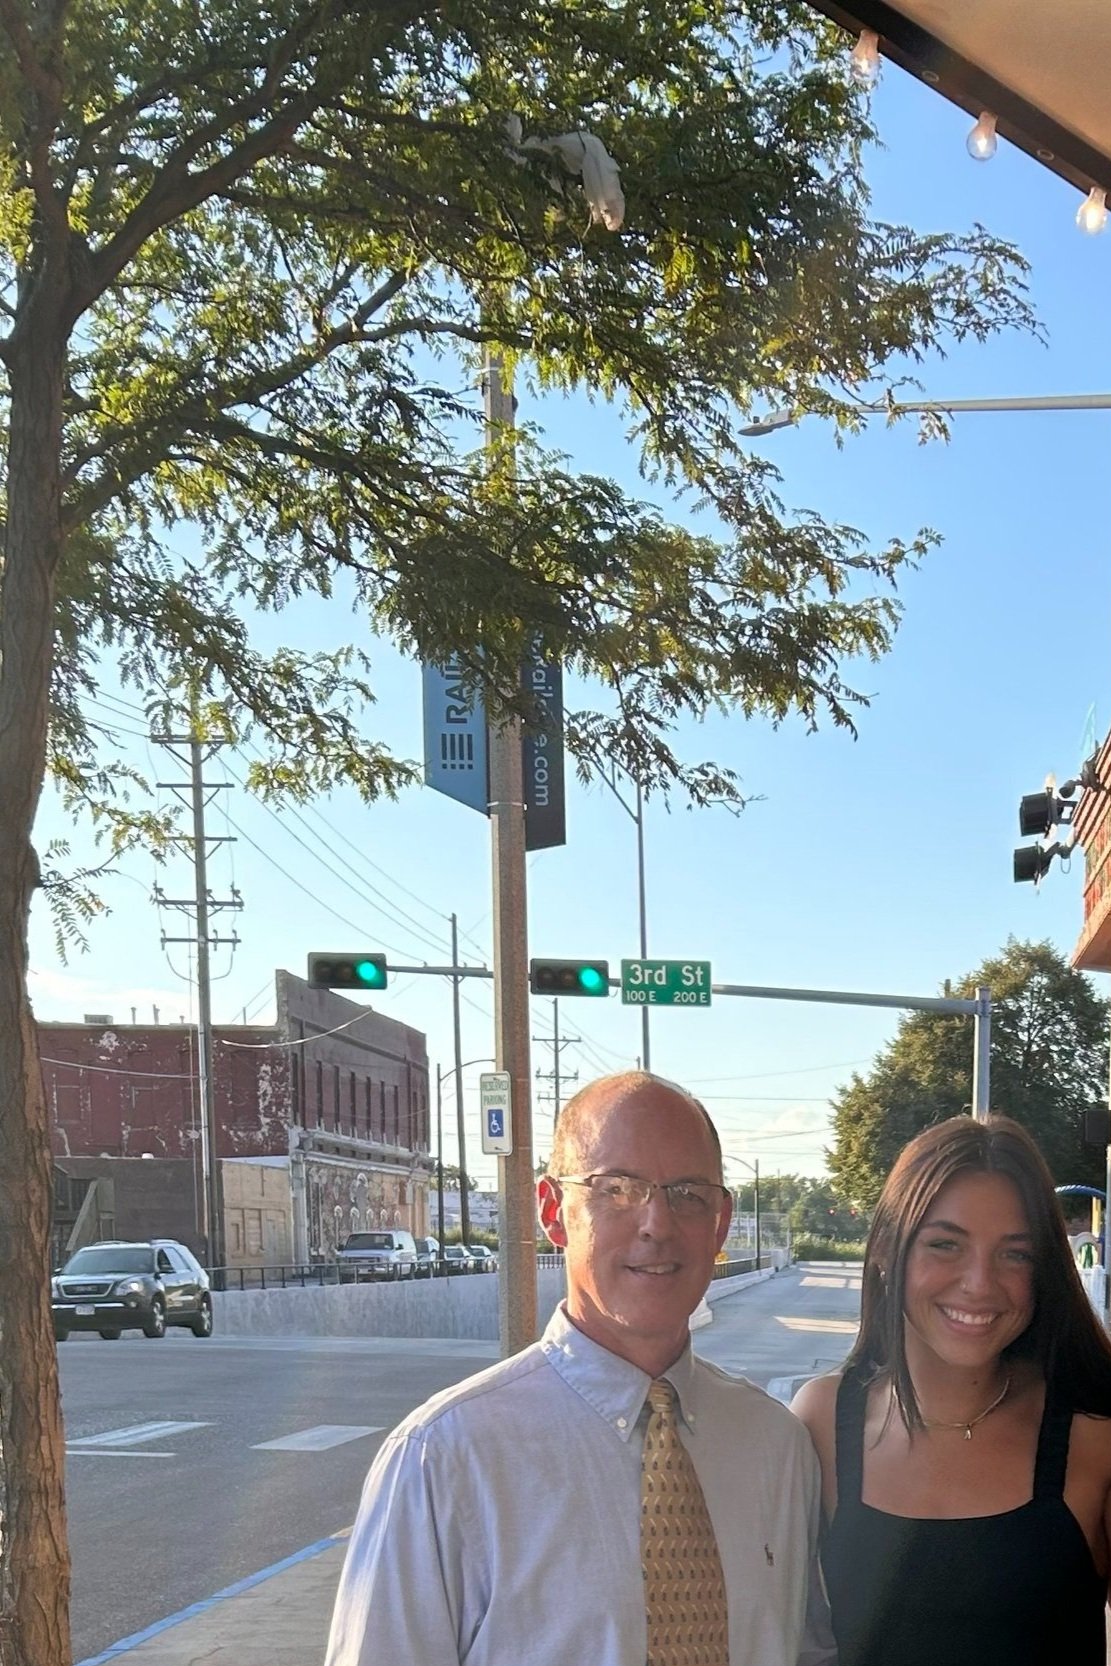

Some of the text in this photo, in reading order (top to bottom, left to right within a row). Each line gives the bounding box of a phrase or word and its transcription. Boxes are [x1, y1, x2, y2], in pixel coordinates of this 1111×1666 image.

[629, 963, 703, 986] 3rd St
[625, 990, 657, 1002] 100 E
[673, 991, 708, 1003] 200 E
[481, 1080, 508, 1091] RESERVED
[483, 1094, 506, 1105] PARKING
